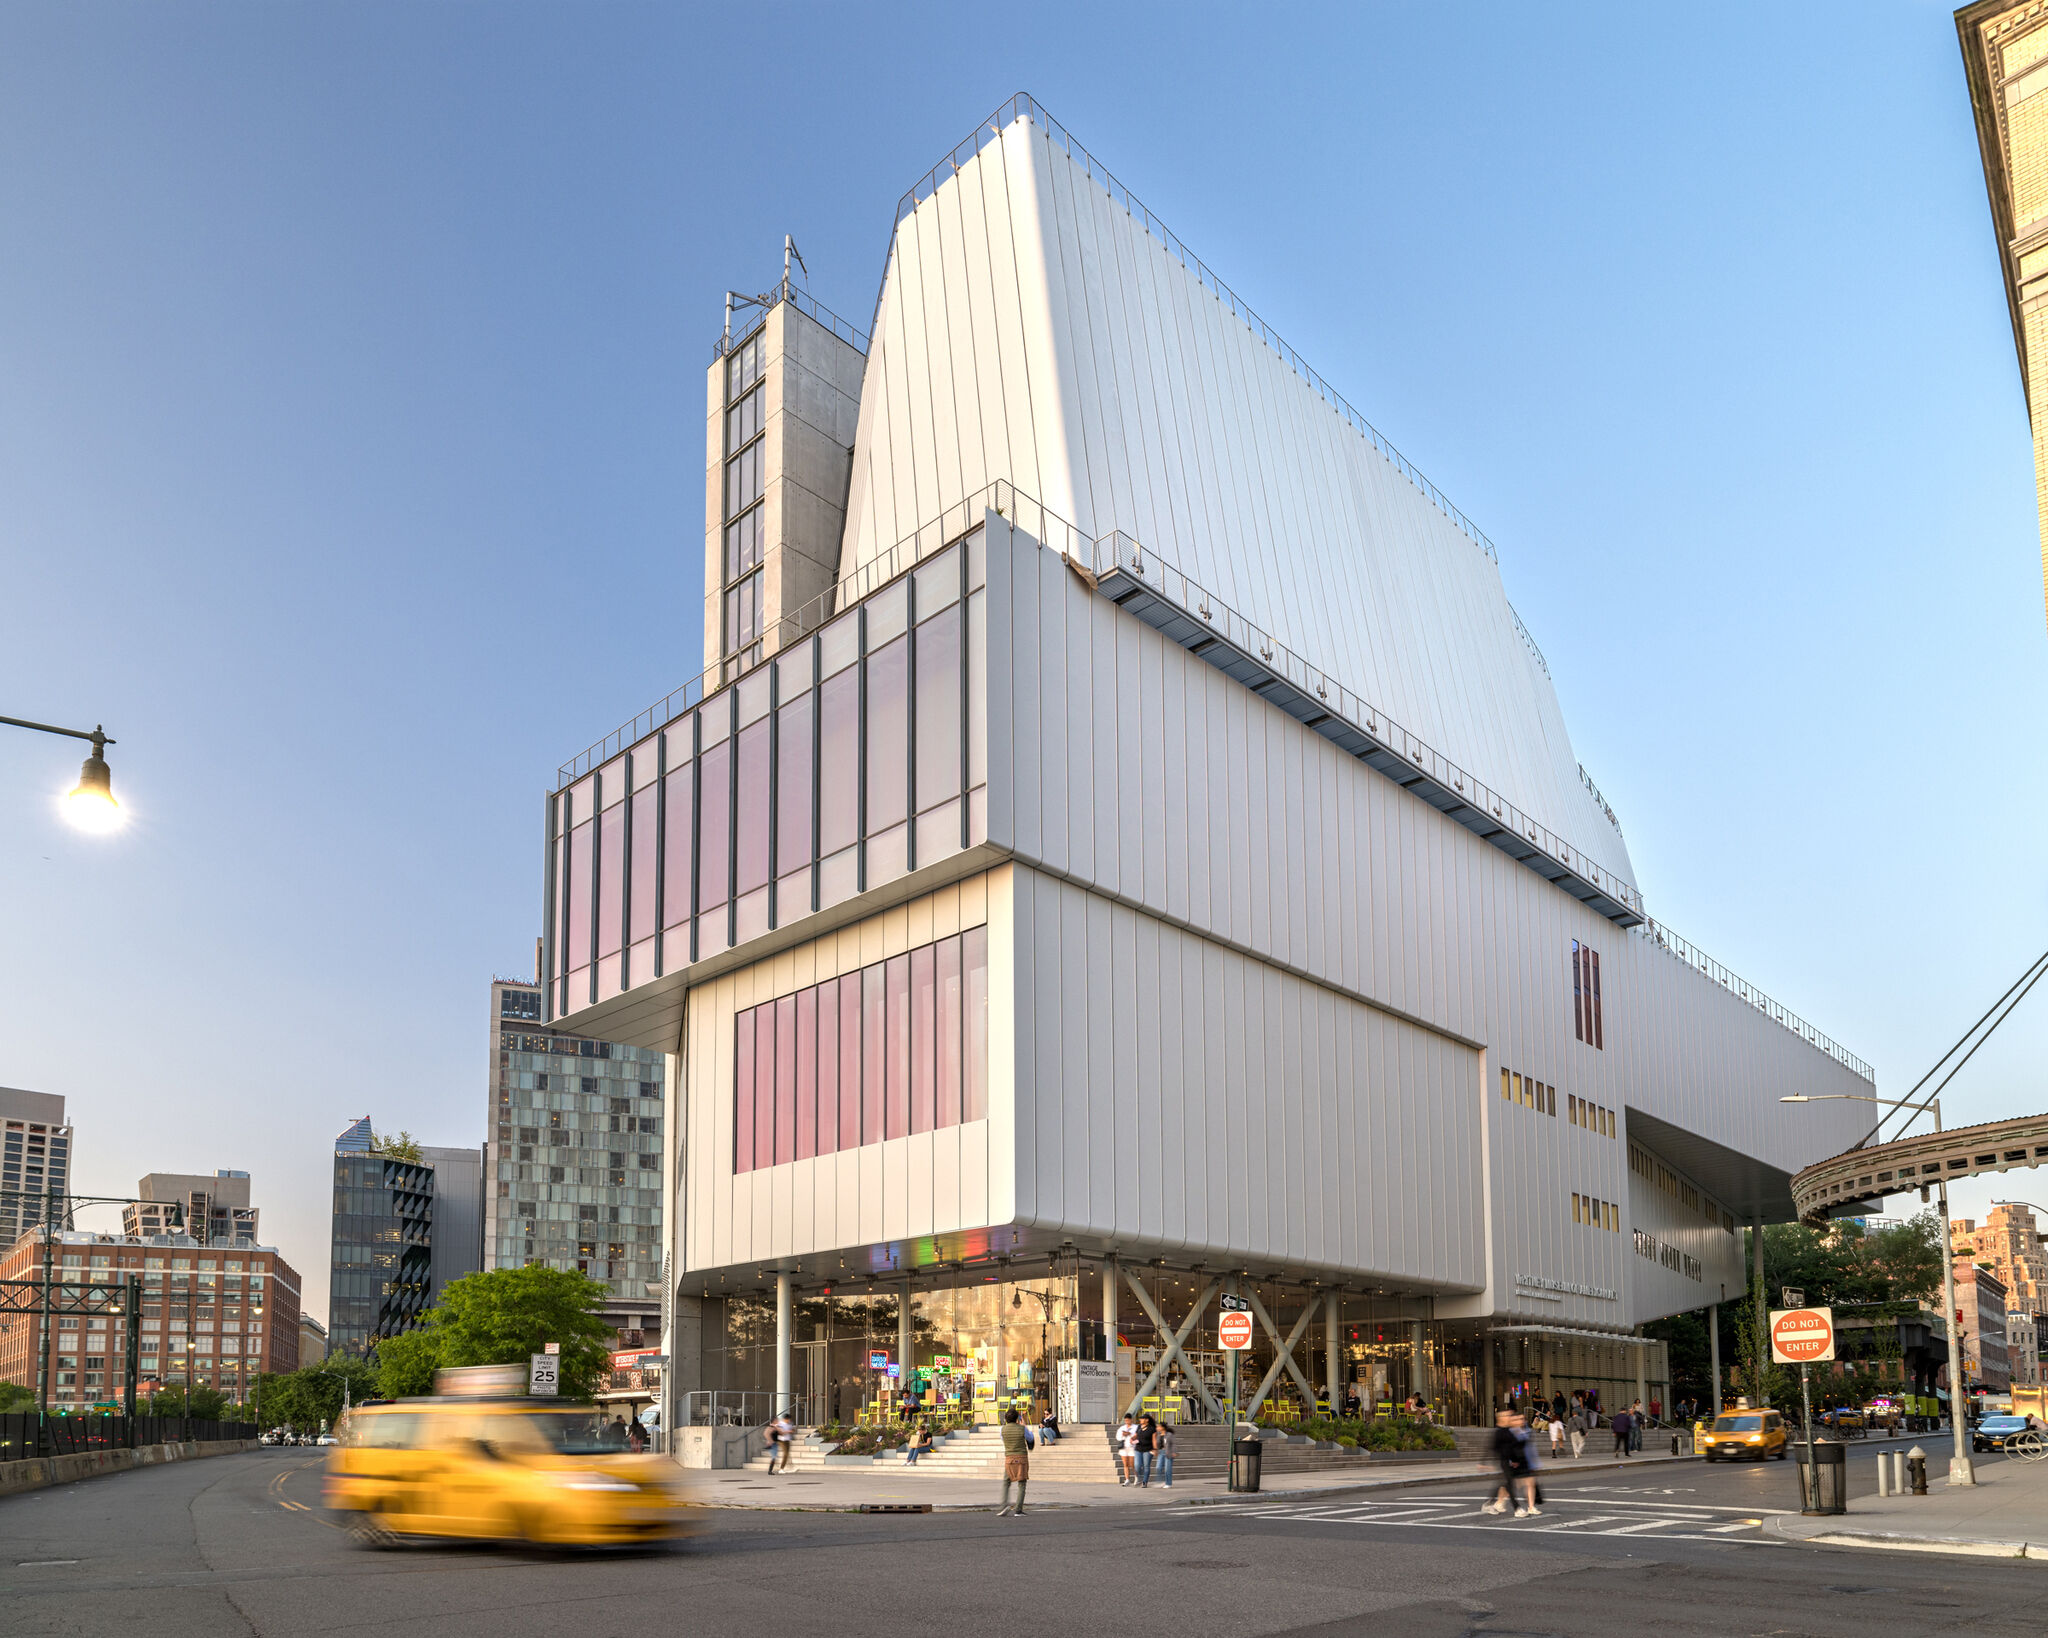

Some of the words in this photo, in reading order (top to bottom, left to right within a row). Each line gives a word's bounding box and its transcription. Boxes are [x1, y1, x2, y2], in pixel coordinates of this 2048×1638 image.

[1782, 1321, 1796, 1330] DO
[1800, 1319, 1819, 1328] NOT
[1786, 1342, 1819, 1352] ENTER
[535, 1370, 555, 1382] 25
